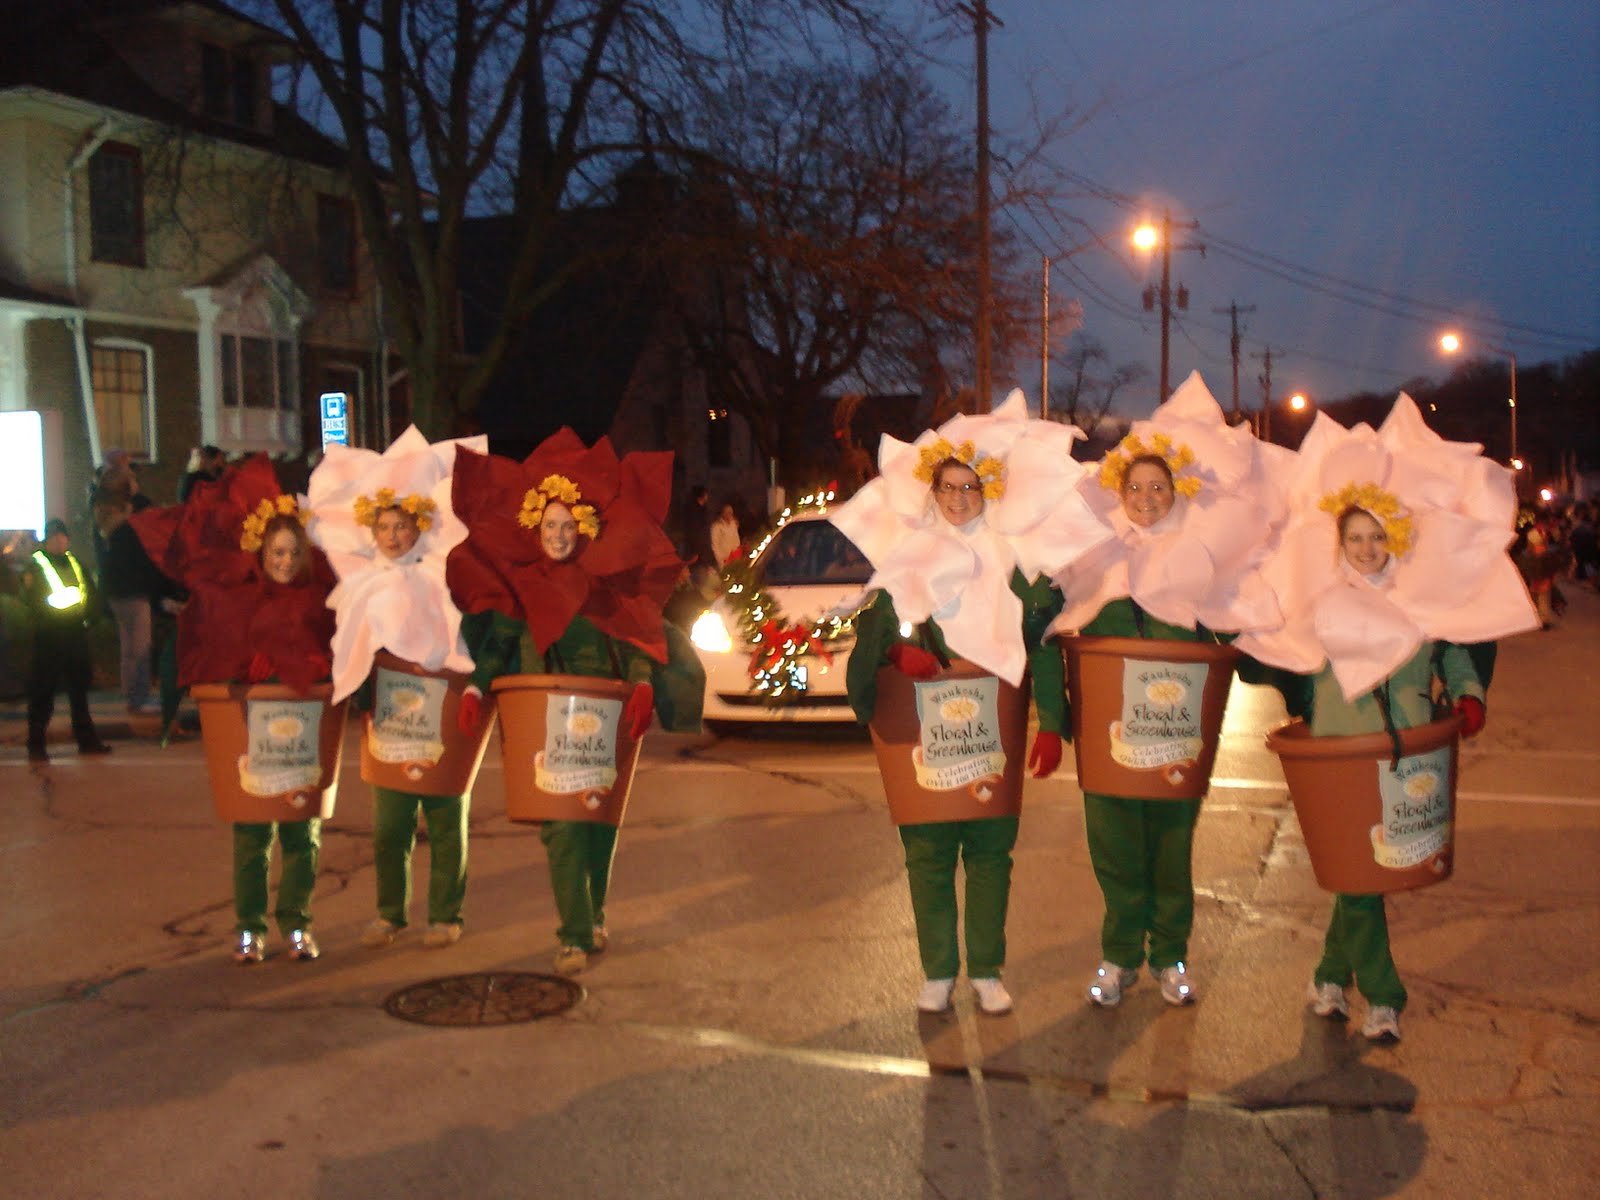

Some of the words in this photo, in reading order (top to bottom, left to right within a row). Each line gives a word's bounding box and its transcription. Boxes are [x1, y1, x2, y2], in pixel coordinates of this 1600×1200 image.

[930, 686, 985, 704] Waukesha
[1132, 703, 1175, 721] Floral
[1177, 707, 1191, 721] &
[930, 721, 973, 742] Floral
[976, 722, 990, 737] &
[1125, 720, 1197, 738] Greenhouse
[555, 733, 593, 751] Floral
[594, 738, 607, 751] &
[926, 738, 998, 760] Greenhouse
[937, 756, 991, 778] Celebrating
[926, 778, 953, 788] OVER
[956, 774, 970, 785] 100
[1393, 798, 1432, 818] Floral
